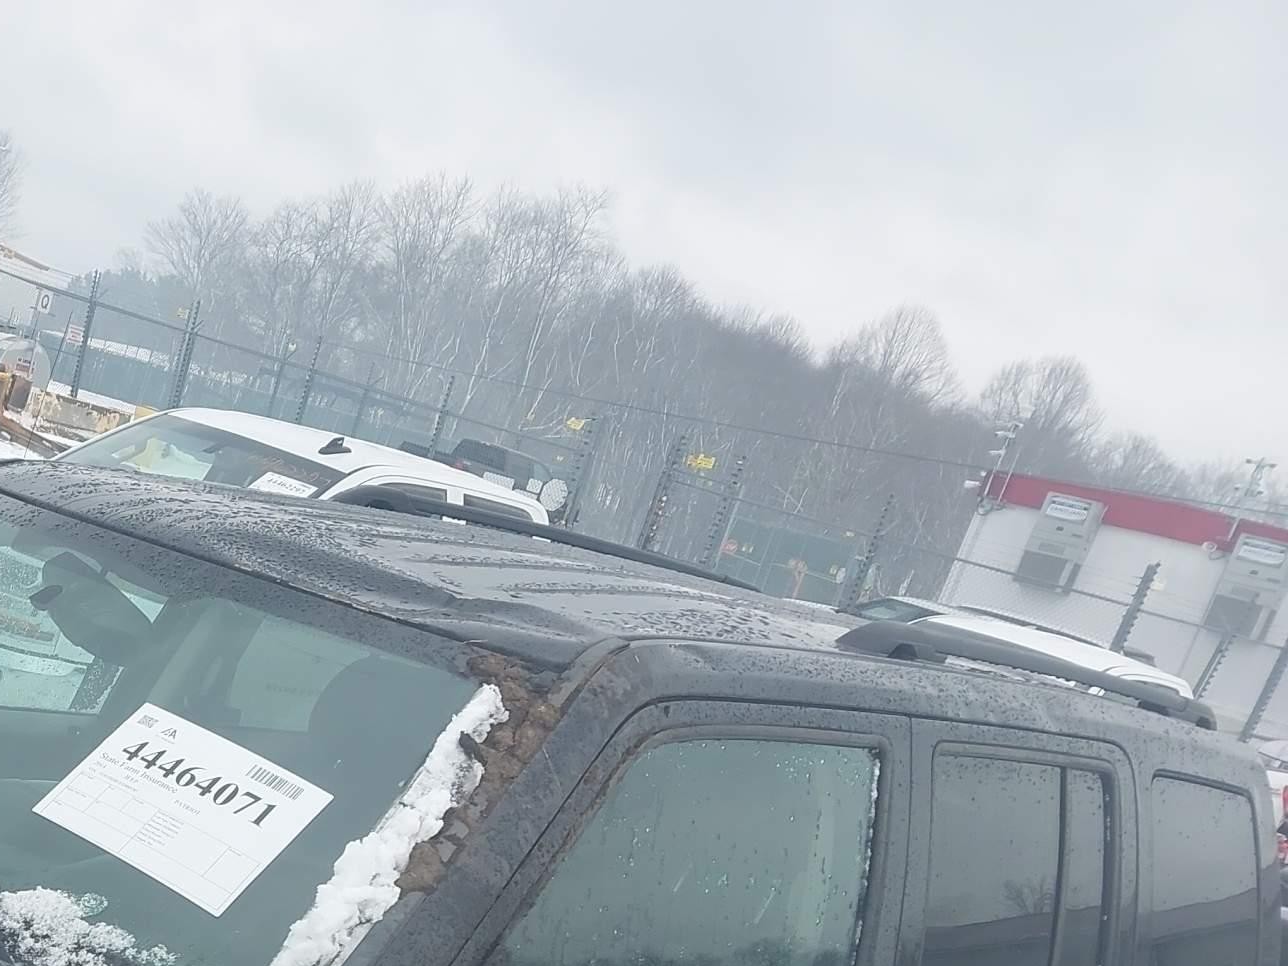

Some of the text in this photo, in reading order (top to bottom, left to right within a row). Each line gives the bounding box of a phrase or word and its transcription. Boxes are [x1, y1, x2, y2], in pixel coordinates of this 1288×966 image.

[40, 294, 50, 309] Q
[100, 752, 120, 767] State
[119, 761, 140, 777] Farm
[140, 769, 179, 794] Insurance
[122, 741, 278, 828] 44464071
